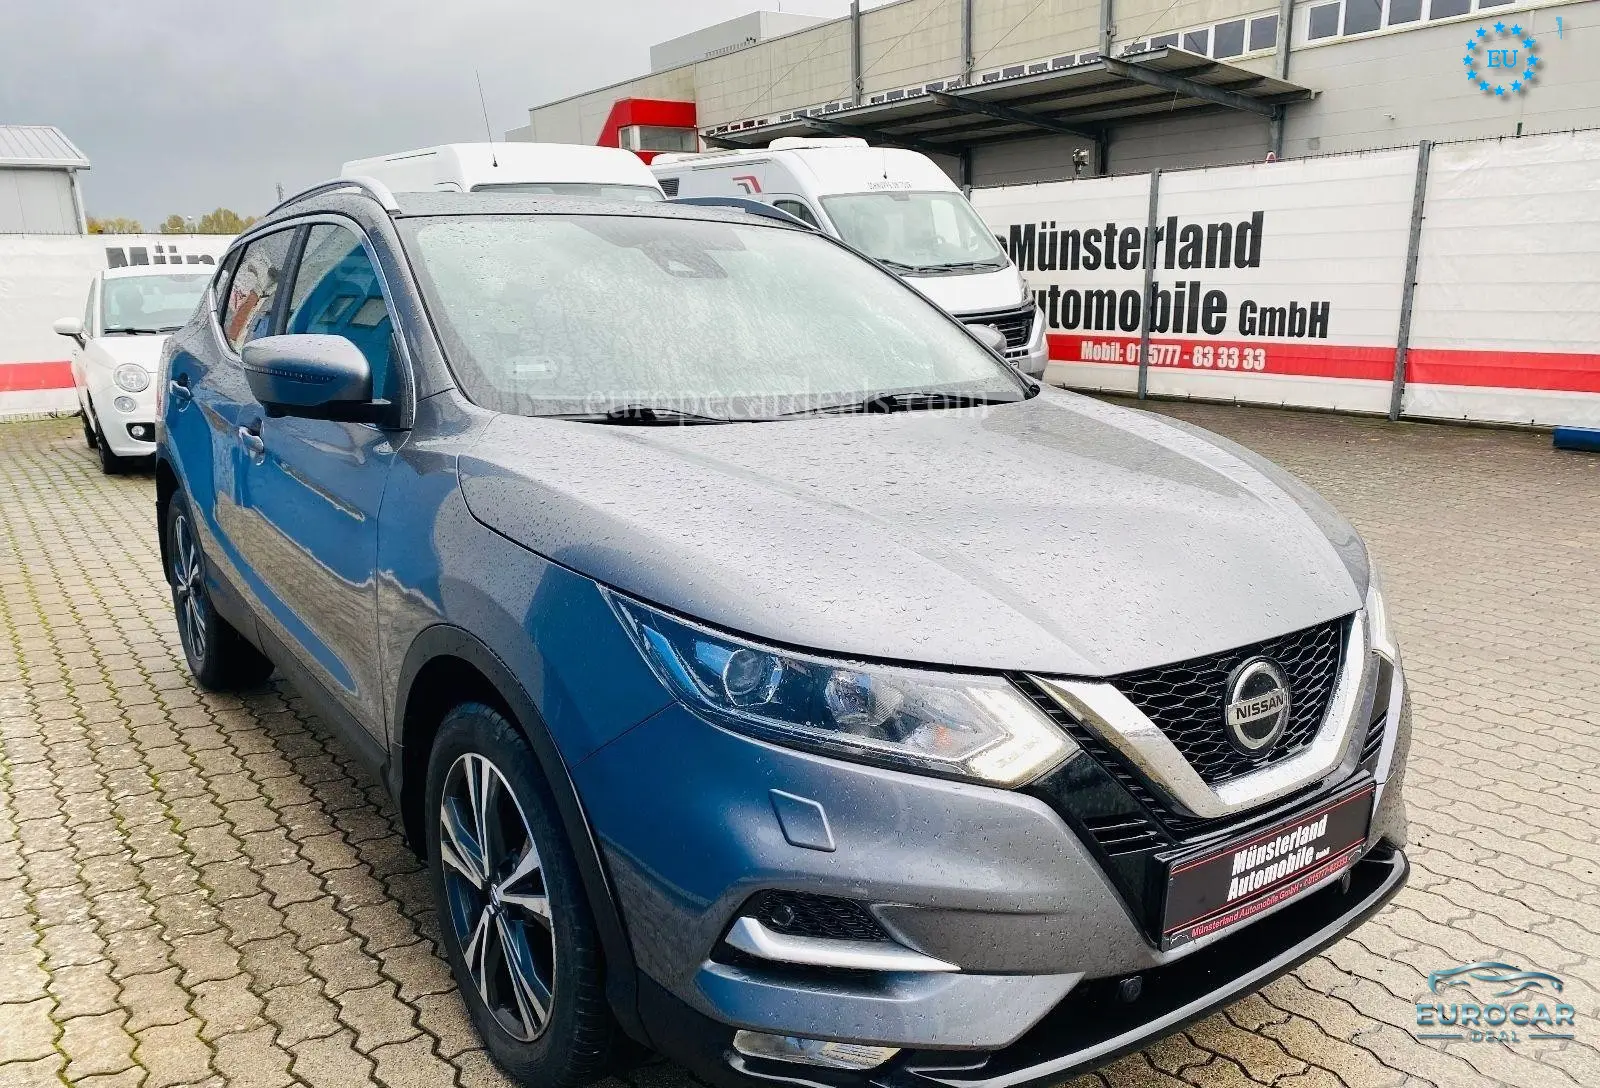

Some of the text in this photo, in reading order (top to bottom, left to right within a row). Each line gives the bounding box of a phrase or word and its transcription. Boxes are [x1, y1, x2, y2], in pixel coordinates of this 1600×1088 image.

[1009, 211, 1264, 272] Münsterland
[1031, 280, 1331, 339] tomobile GmbH
[1080, 340, 1124, 362] Mobil:
[1192, 345, 1215, 368] 83
[1217, 346, 1240, 370] 33
[1242, 347, 1266, 371] 33
[1236, 694, 1284, 720] NISSAN
[1231, 814, 1329, 877] Münsterland
[1226, 846, 1314, 902] Automobile
[1191, 910, 1239, 938] Münsterland
[1239, 893, 1280, 920] Automobile
[1279, 882, 1300, 900] GmbH
